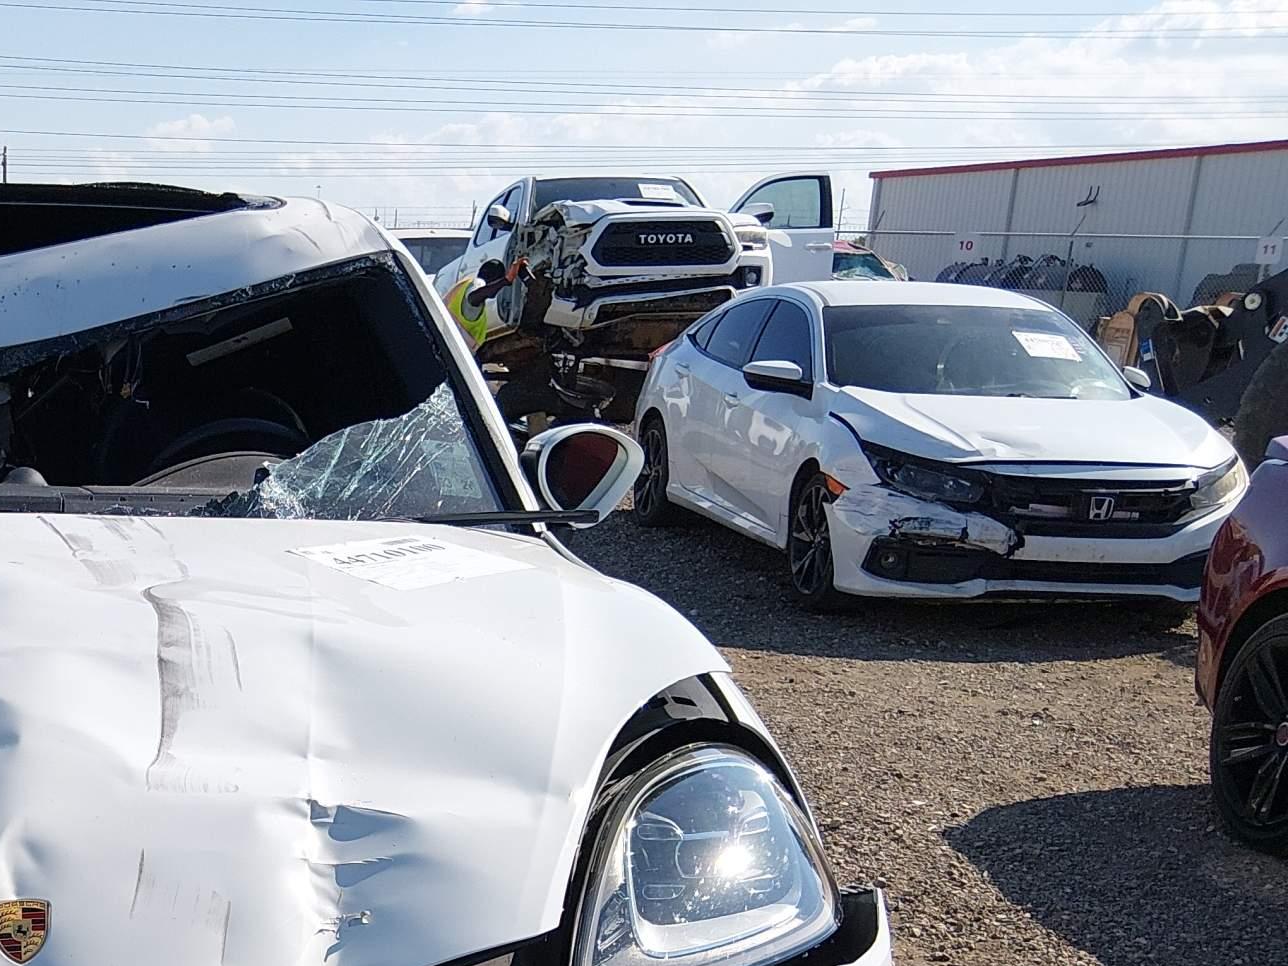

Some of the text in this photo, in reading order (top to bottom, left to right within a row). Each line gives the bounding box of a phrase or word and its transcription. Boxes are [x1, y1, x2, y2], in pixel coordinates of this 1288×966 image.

[639, 233, 693, 244] TOYOTA
[959, 240, 974, 251] 10
[1263, 244, 1277, 255] 11
